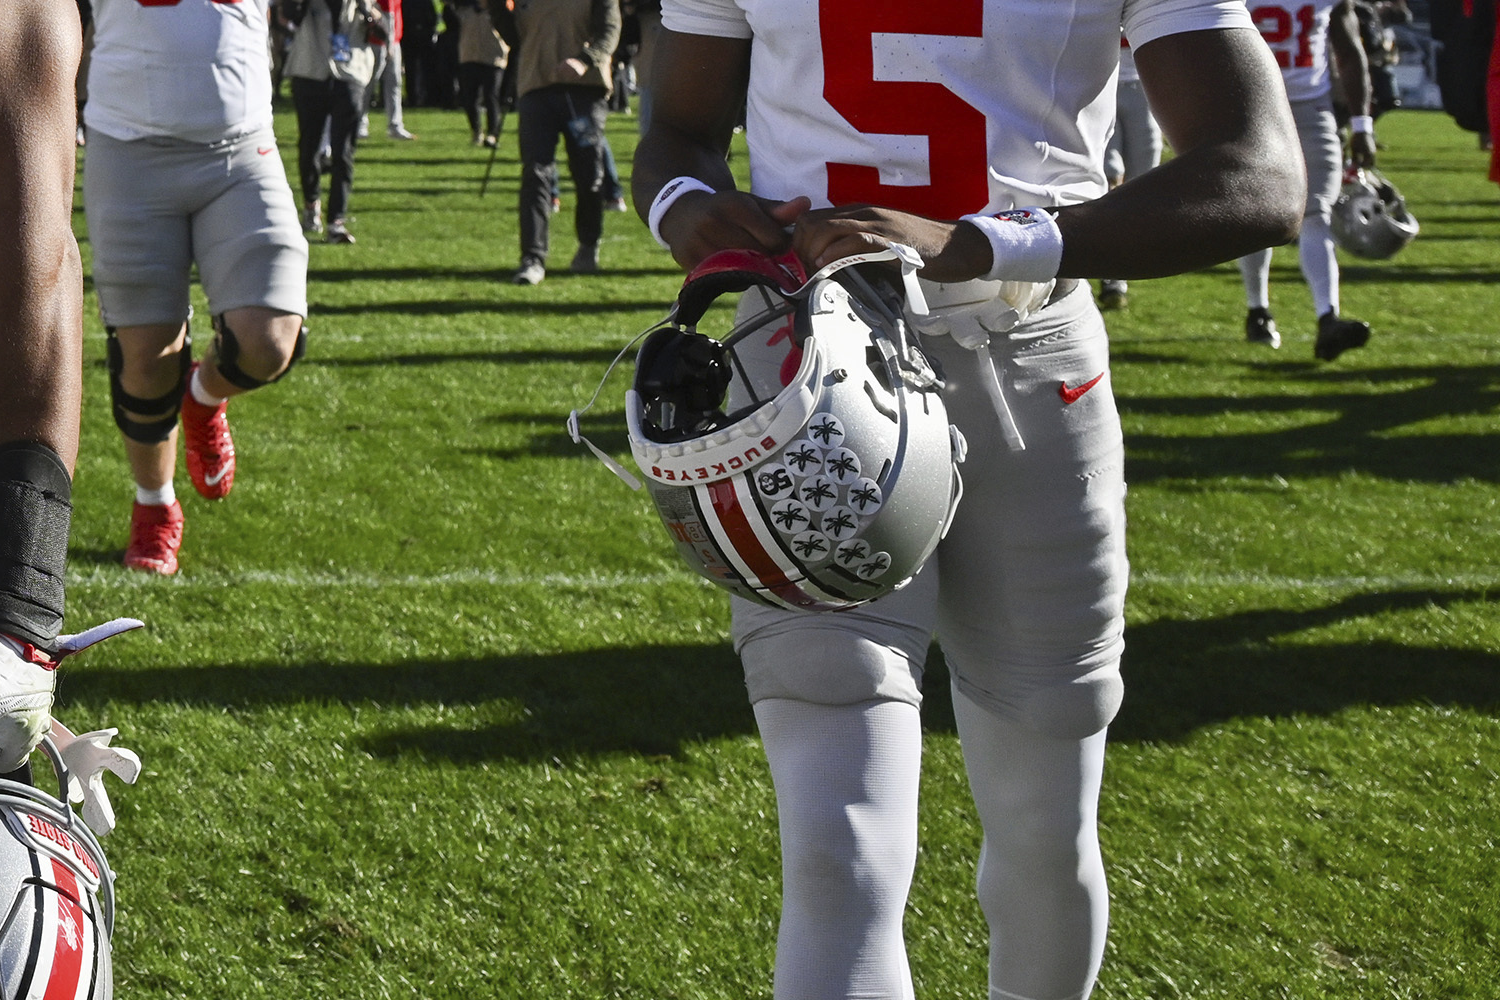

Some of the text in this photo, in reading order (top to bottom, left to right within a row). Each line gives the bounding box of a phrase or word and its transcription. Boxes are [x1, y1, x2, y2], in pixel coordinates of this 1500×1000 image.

[1250, 5, 1315, 68] 21
[651, 435, 777, 482] BUCKEYES
[27, 813, 72, 852] STATE
